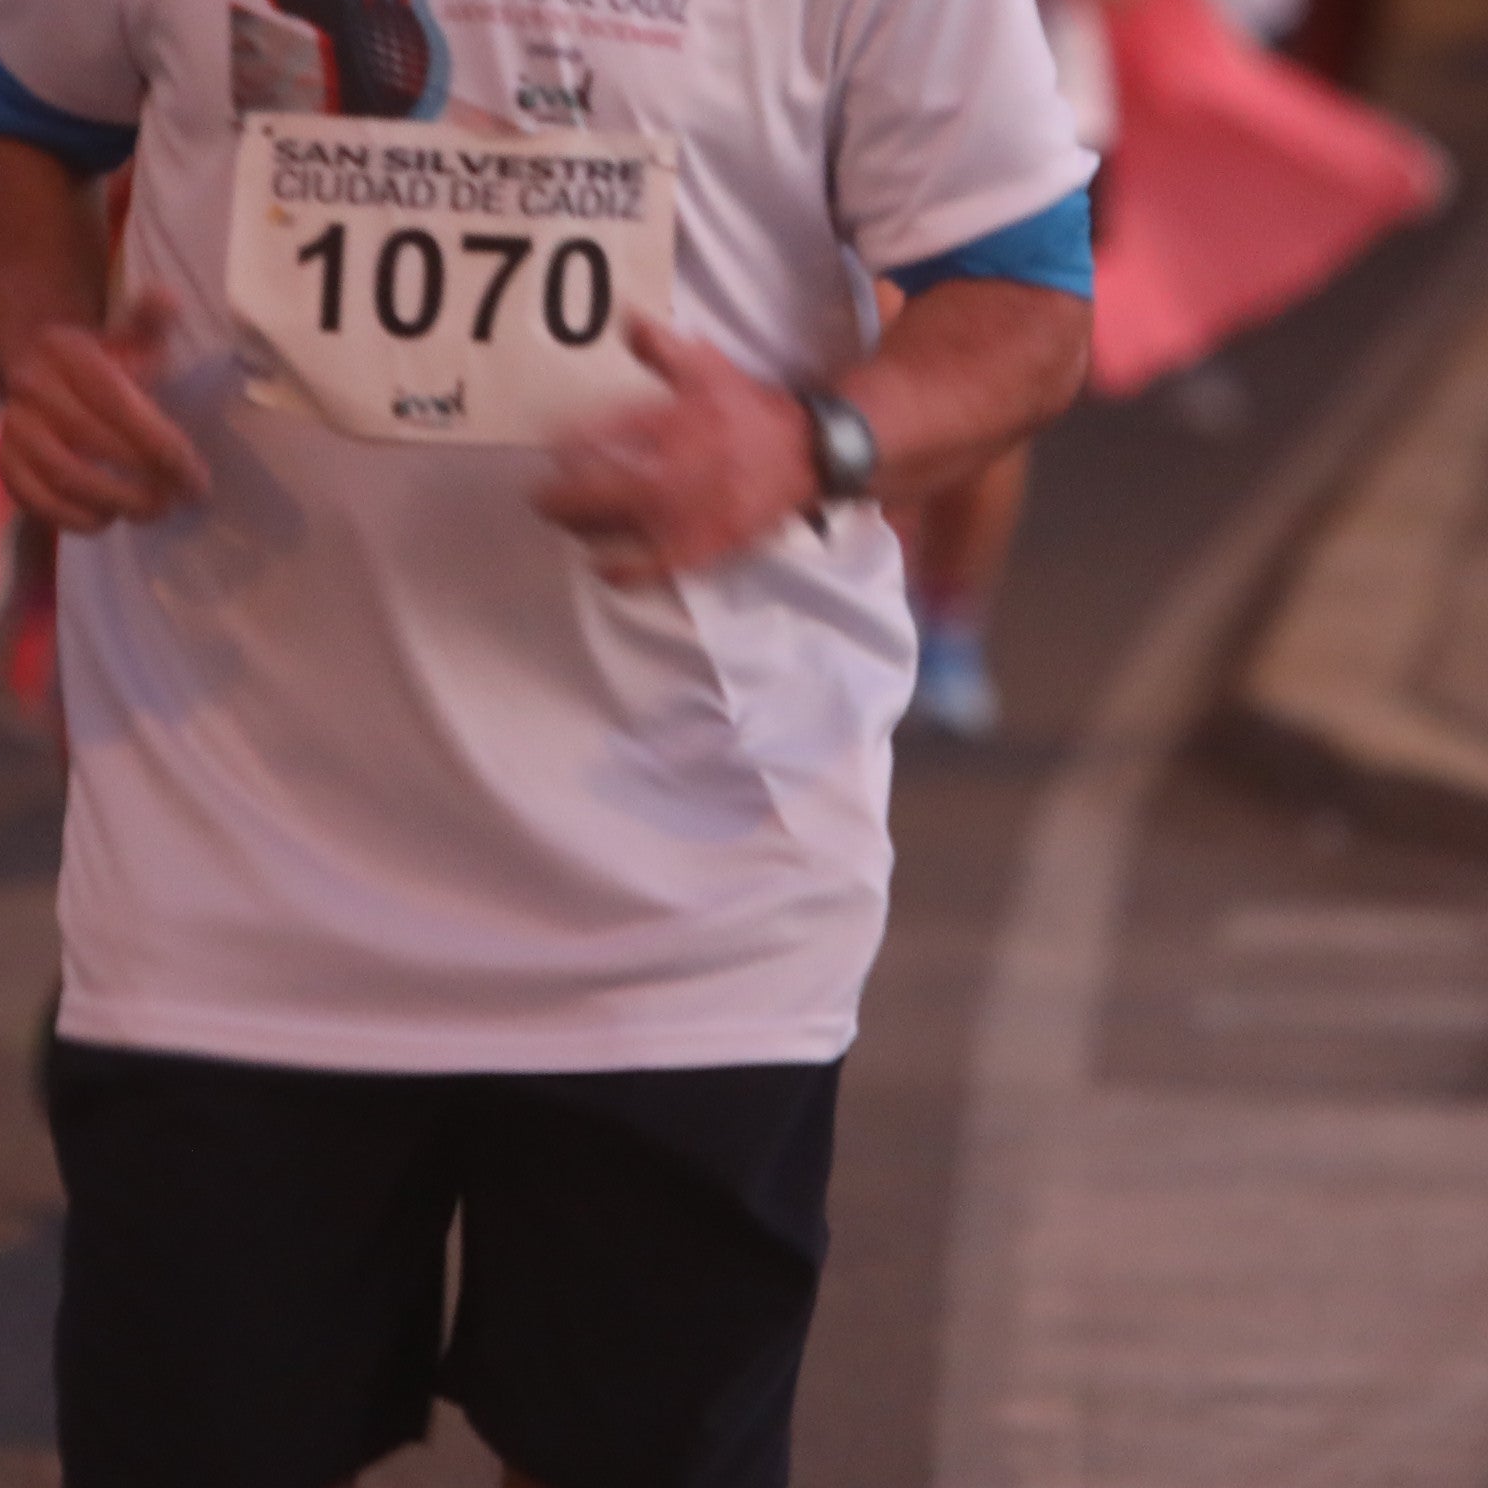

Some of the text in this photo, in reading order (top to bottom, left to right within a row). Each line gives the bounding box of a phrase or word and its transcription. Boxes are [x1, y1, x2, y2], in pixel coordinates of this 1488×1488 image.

[274, 138, 643, 184] SAN SILVESTRE
[273, 168, 438, 207] CIUDAD
[449, 177, 504, 214] DE
[298, 222, 610, 347] 1070
